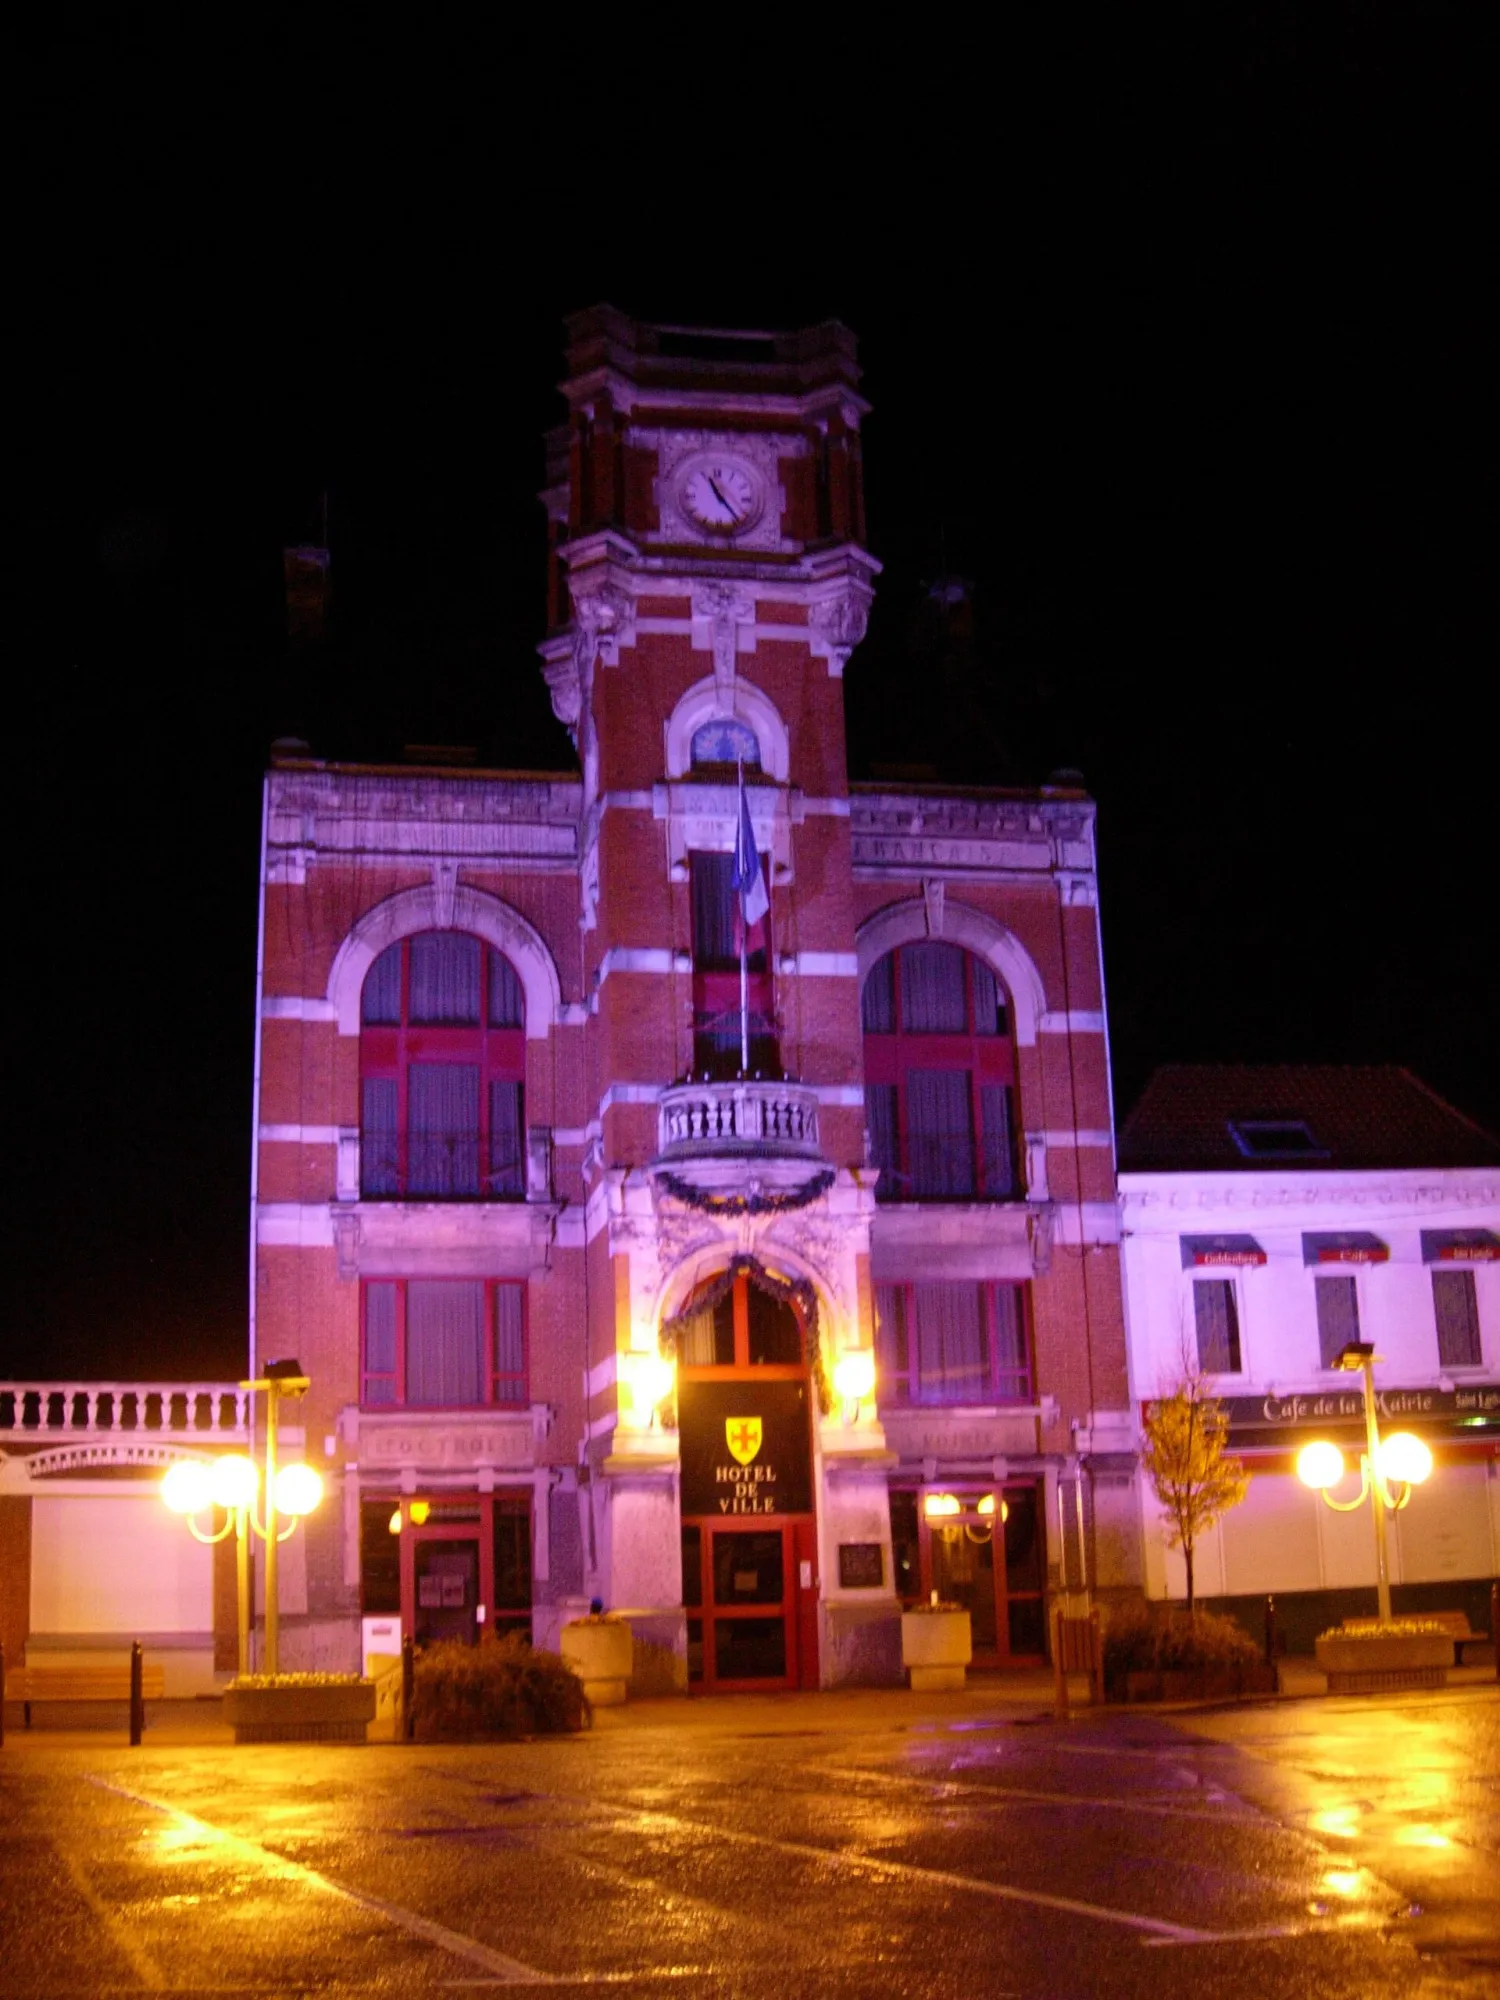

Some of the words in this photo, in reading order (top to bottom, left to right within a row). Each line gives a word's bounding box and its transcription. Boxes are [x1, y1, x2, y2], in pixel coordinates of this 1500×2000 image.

[1313, 1396, 1334, 1415] de
[1340, 1396, 1356, 1415] la
[1361, 1391, 1432, 1419] Mairie
[735, 1481, 758, 1498] DE
[719, 1496, 775, 1515] VILLE
